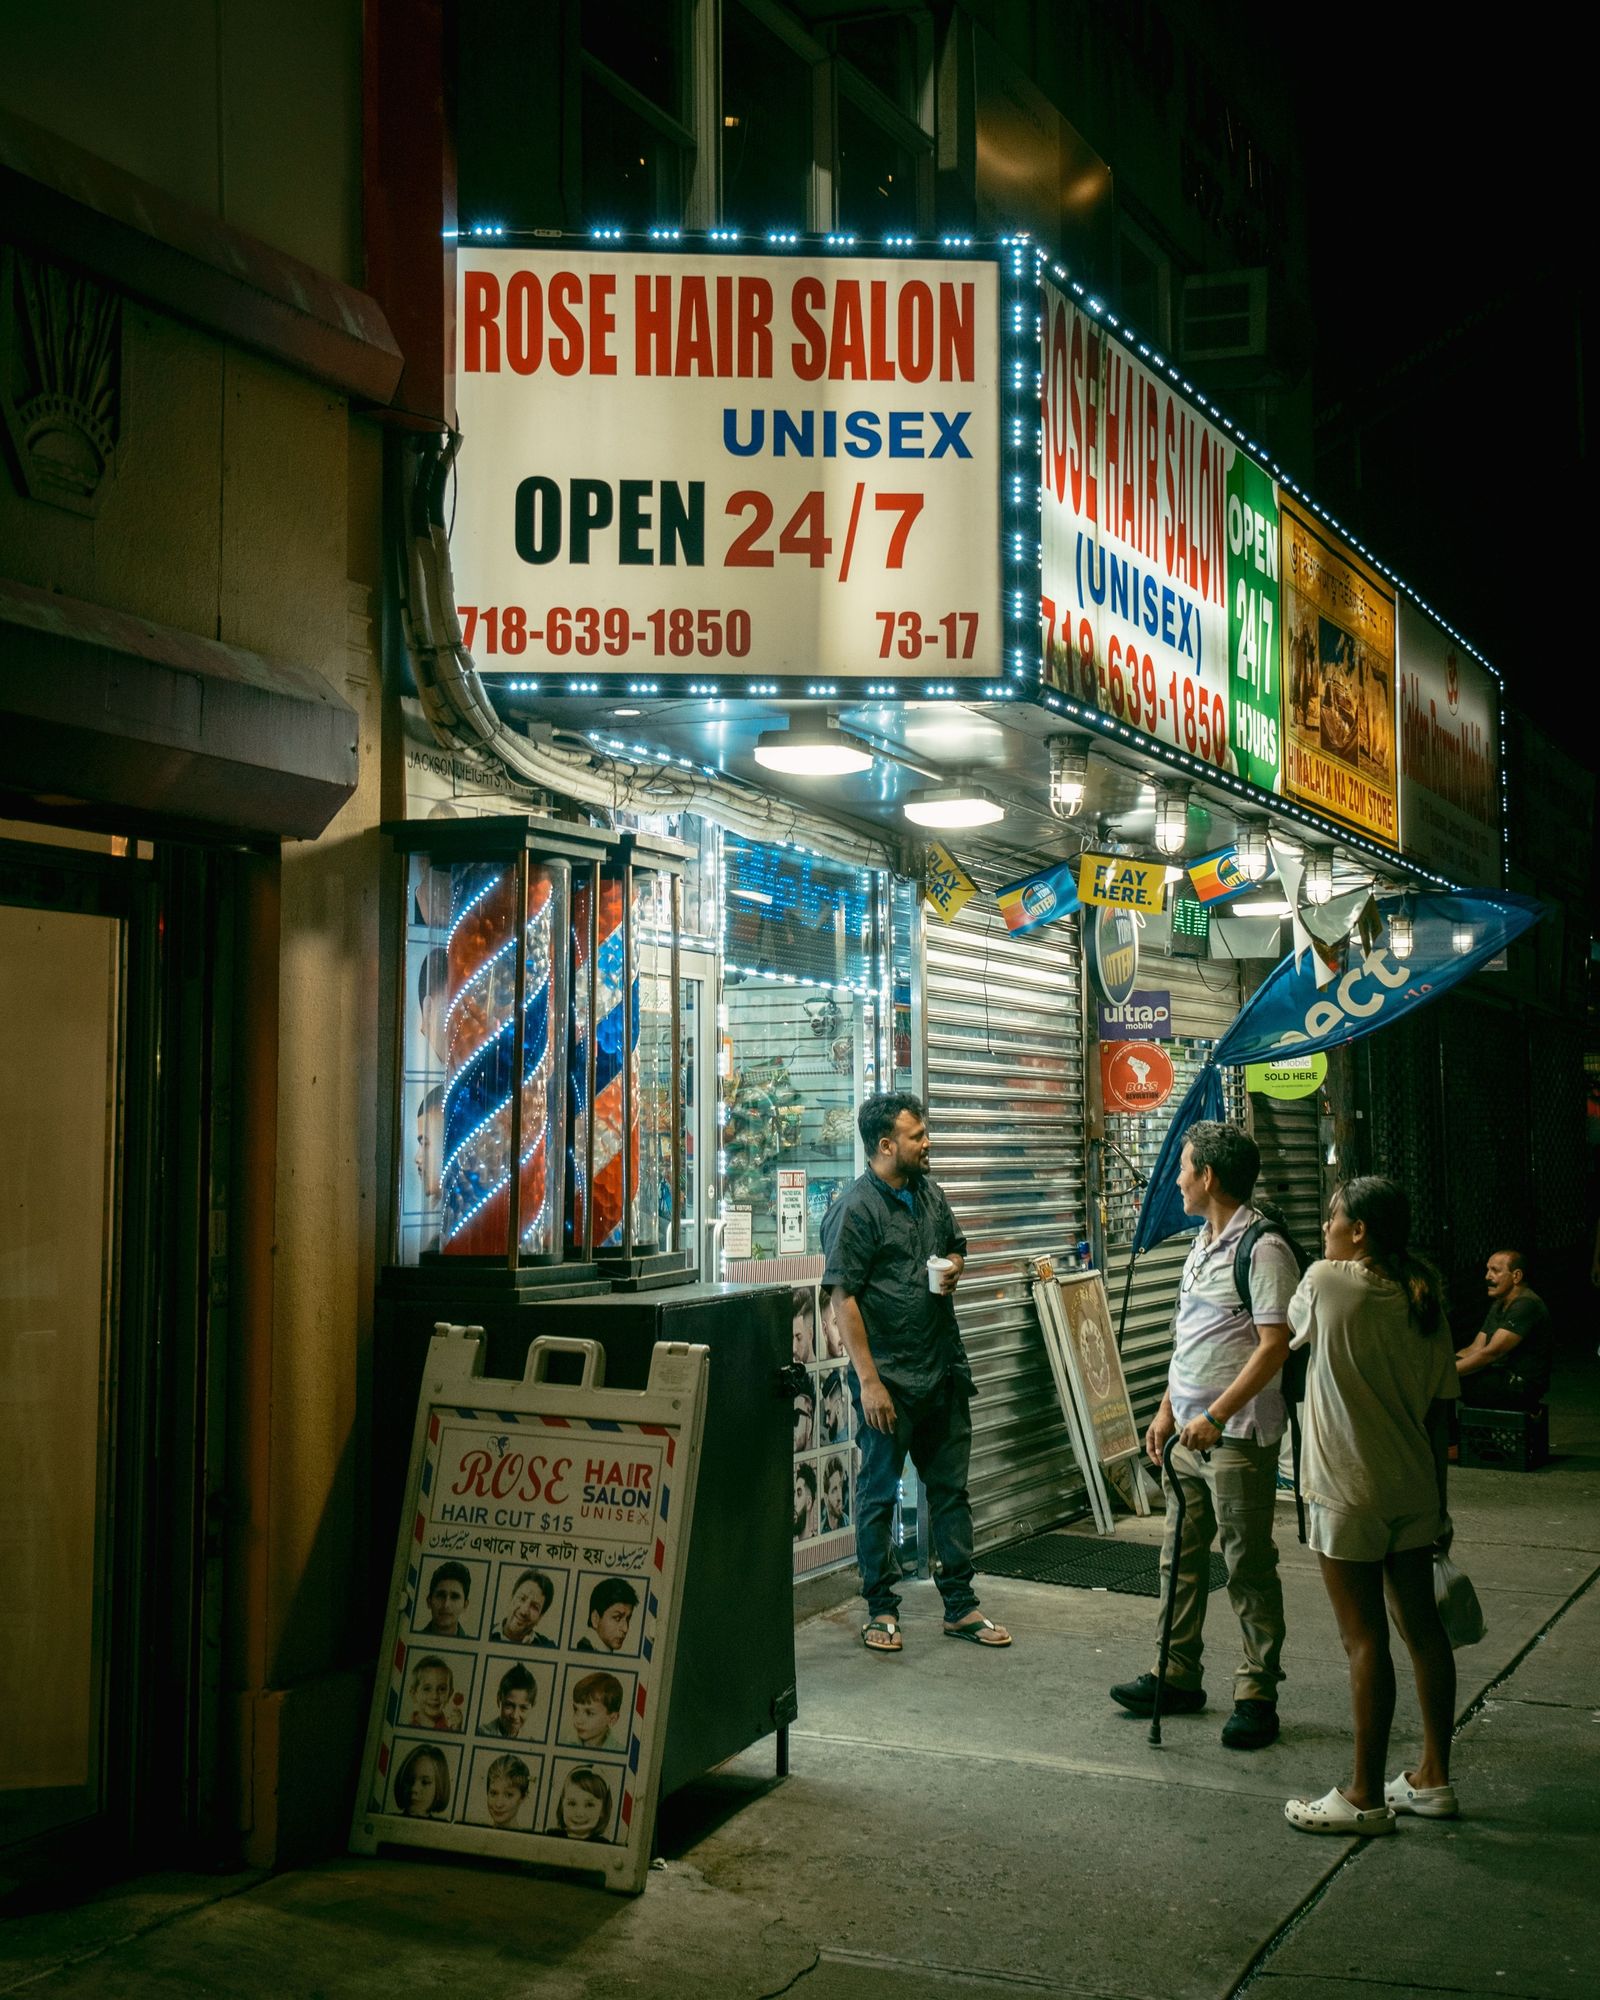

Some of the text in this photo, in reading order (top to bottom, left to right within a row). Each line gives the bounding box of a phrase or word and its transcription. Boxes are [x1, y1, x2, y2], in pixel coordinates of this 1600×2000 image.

[464, 270, 975, 383] ROSE HAIR SALON
[723, 408, 973, 459] UNISEX
[1106, 346, 1159, 564] HAIR
[1164, 395, 1225, 608] SALON
[514, 476, 924, 583] OPEN 24/7
[1228, 493, 1278, 583] OPEN
[1076, 533, 1202, 676] (UNISEX)
[458, 606, 751, 658] 718-639-1850
[875, 611, 979, 659] 73-17
[1236, 578, 1273, 701] 24/7
[1041, 594, 1225, 767] 718-639-1850
[407, 751, 454, 776] JACKSON
[1334, 768, 1347, 808] NA
[1368, 787, 1393, 830] STORE
[1093, 882, 1152, 905] HERE.
[1104, 1003, 1153, 1023] ultra
[1125, 1022, 1153, 1030] mobile
[1125, 1081, 1158, 1093] BOSS
[1264, 1072, 1318, 1081] SOLD HERE
[451, 1449, 573, 1504] ROSE
[582, 1485, 651, 1509] SALON
[584, 1459, 653, 1489] HAIR
[441, 1503, 574, 1533] HAIR CUT $15
[470, 1536, 514, 1555] এখানে
[520, 1541, 541, 1561] চুল
[546, 1541, 577, 1562] কাটা
